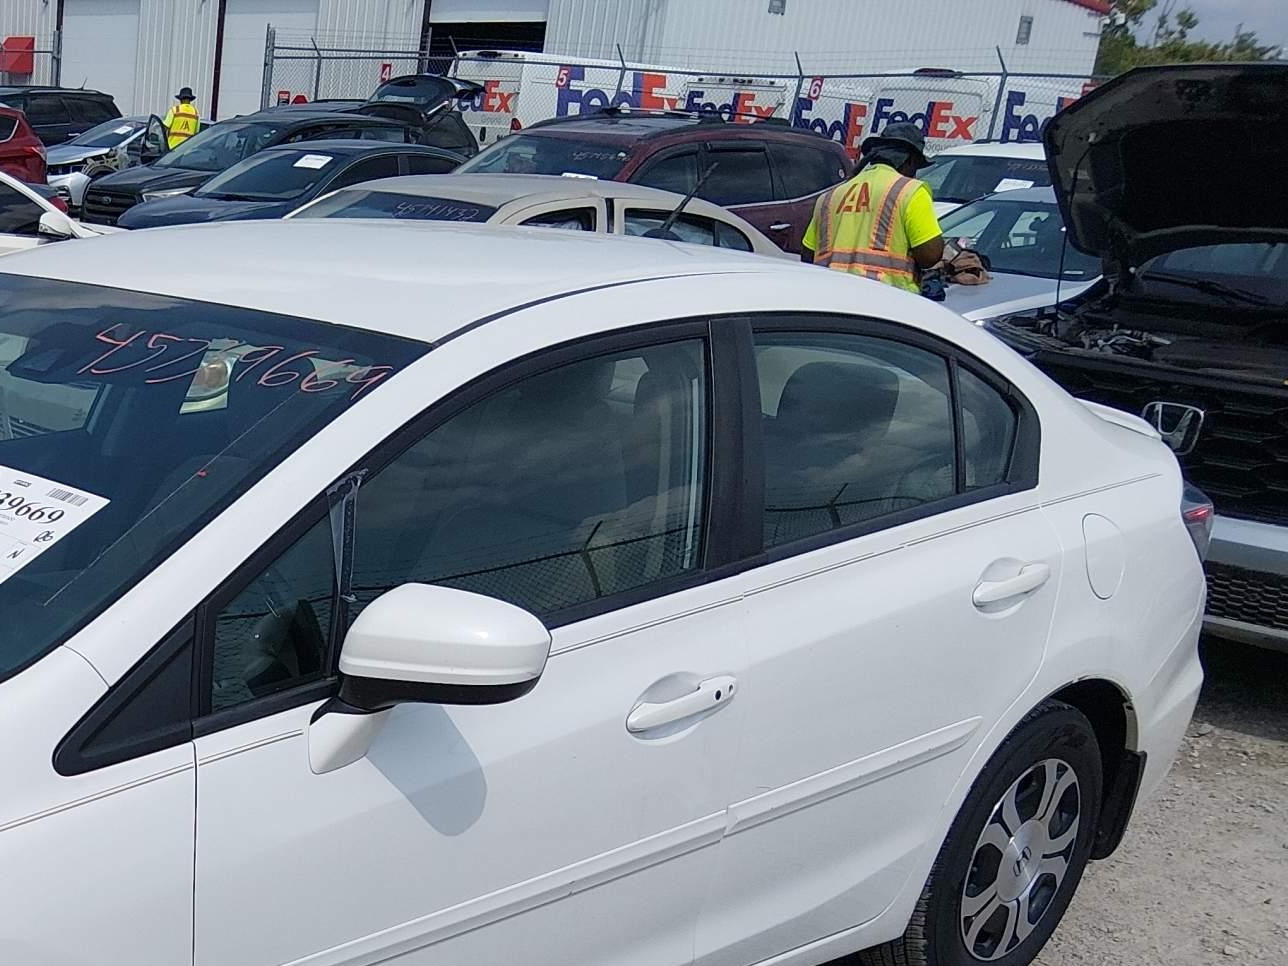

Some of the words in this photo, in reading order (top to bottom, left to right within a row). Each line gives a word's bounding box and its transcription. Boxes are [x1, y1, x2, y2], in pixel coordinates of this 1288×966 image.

[382, 66, 391, 81] 4
[557, 69, 569, 86] 5
[810, 80, 822, 99] 6
